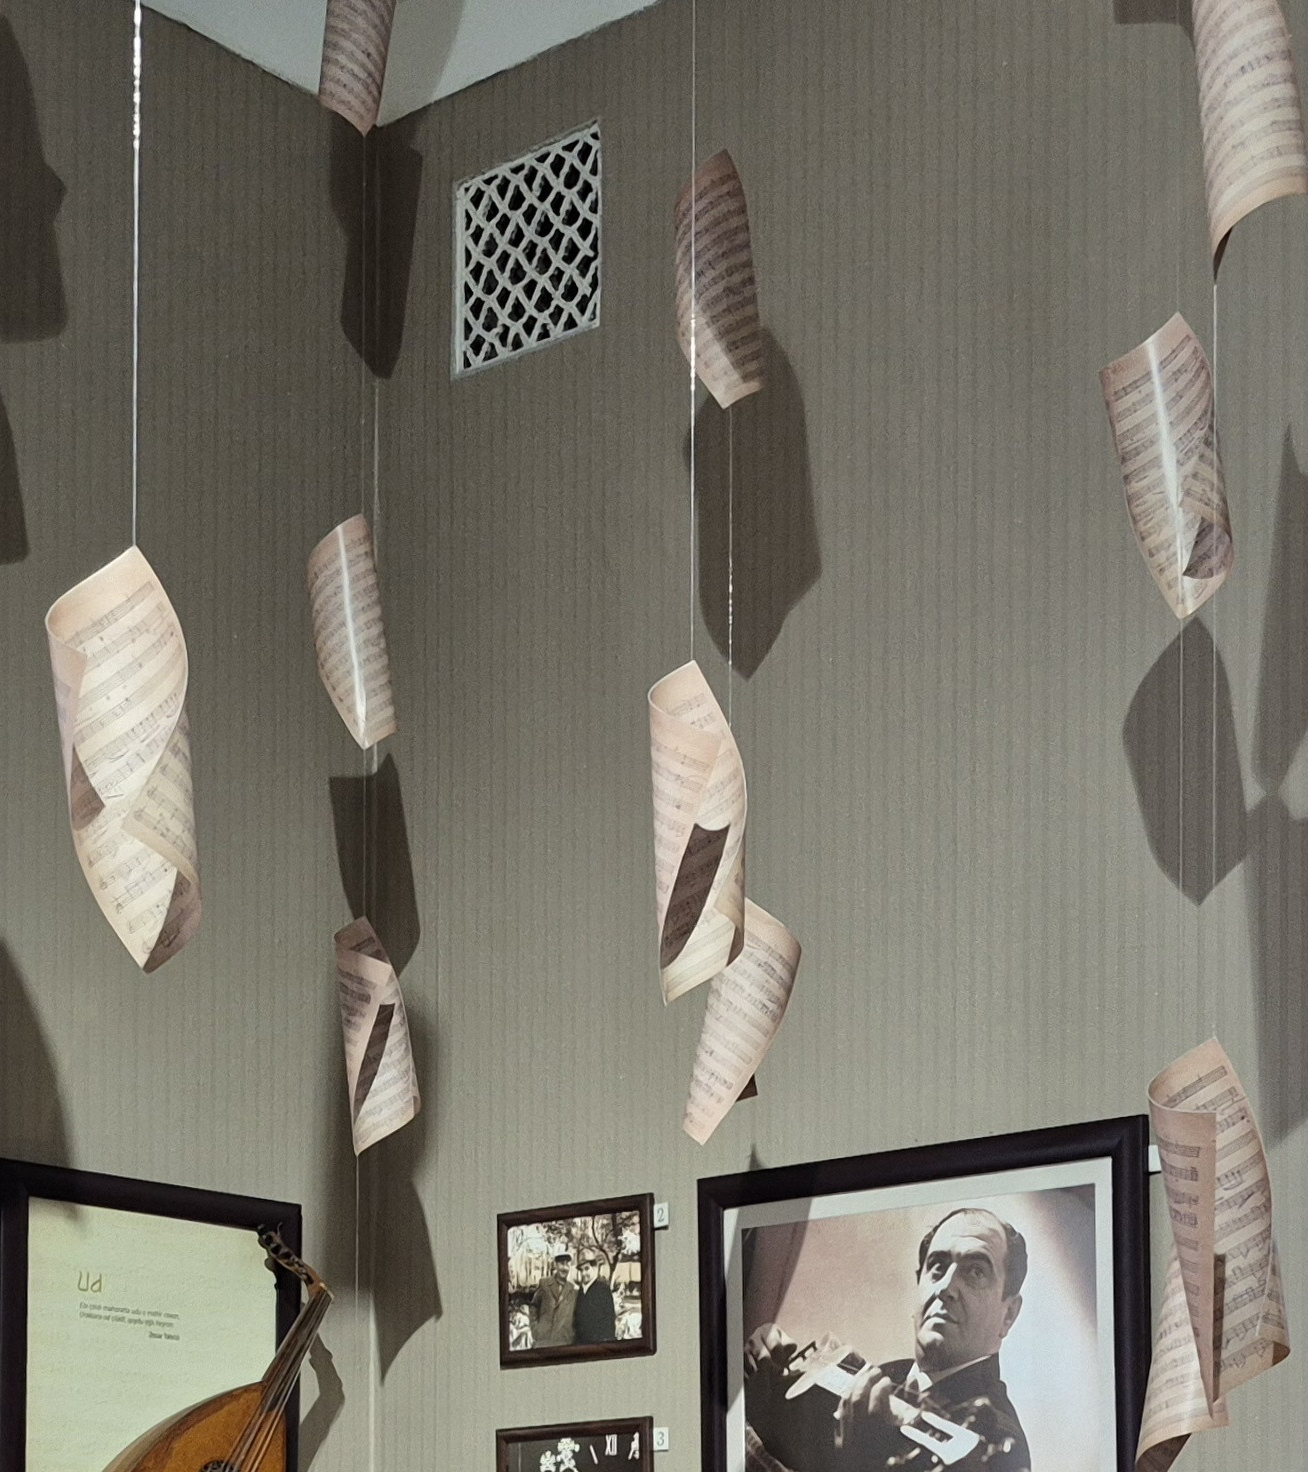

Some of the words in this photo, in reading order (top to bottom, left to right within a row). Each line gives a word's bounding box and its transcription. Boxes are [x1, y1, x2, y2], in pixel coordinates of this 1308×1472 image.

[657, 1208, 664, 1222] 2
[77, 1270, 102, 1293] Ud
[656, 1431, 665, 1446] 3
